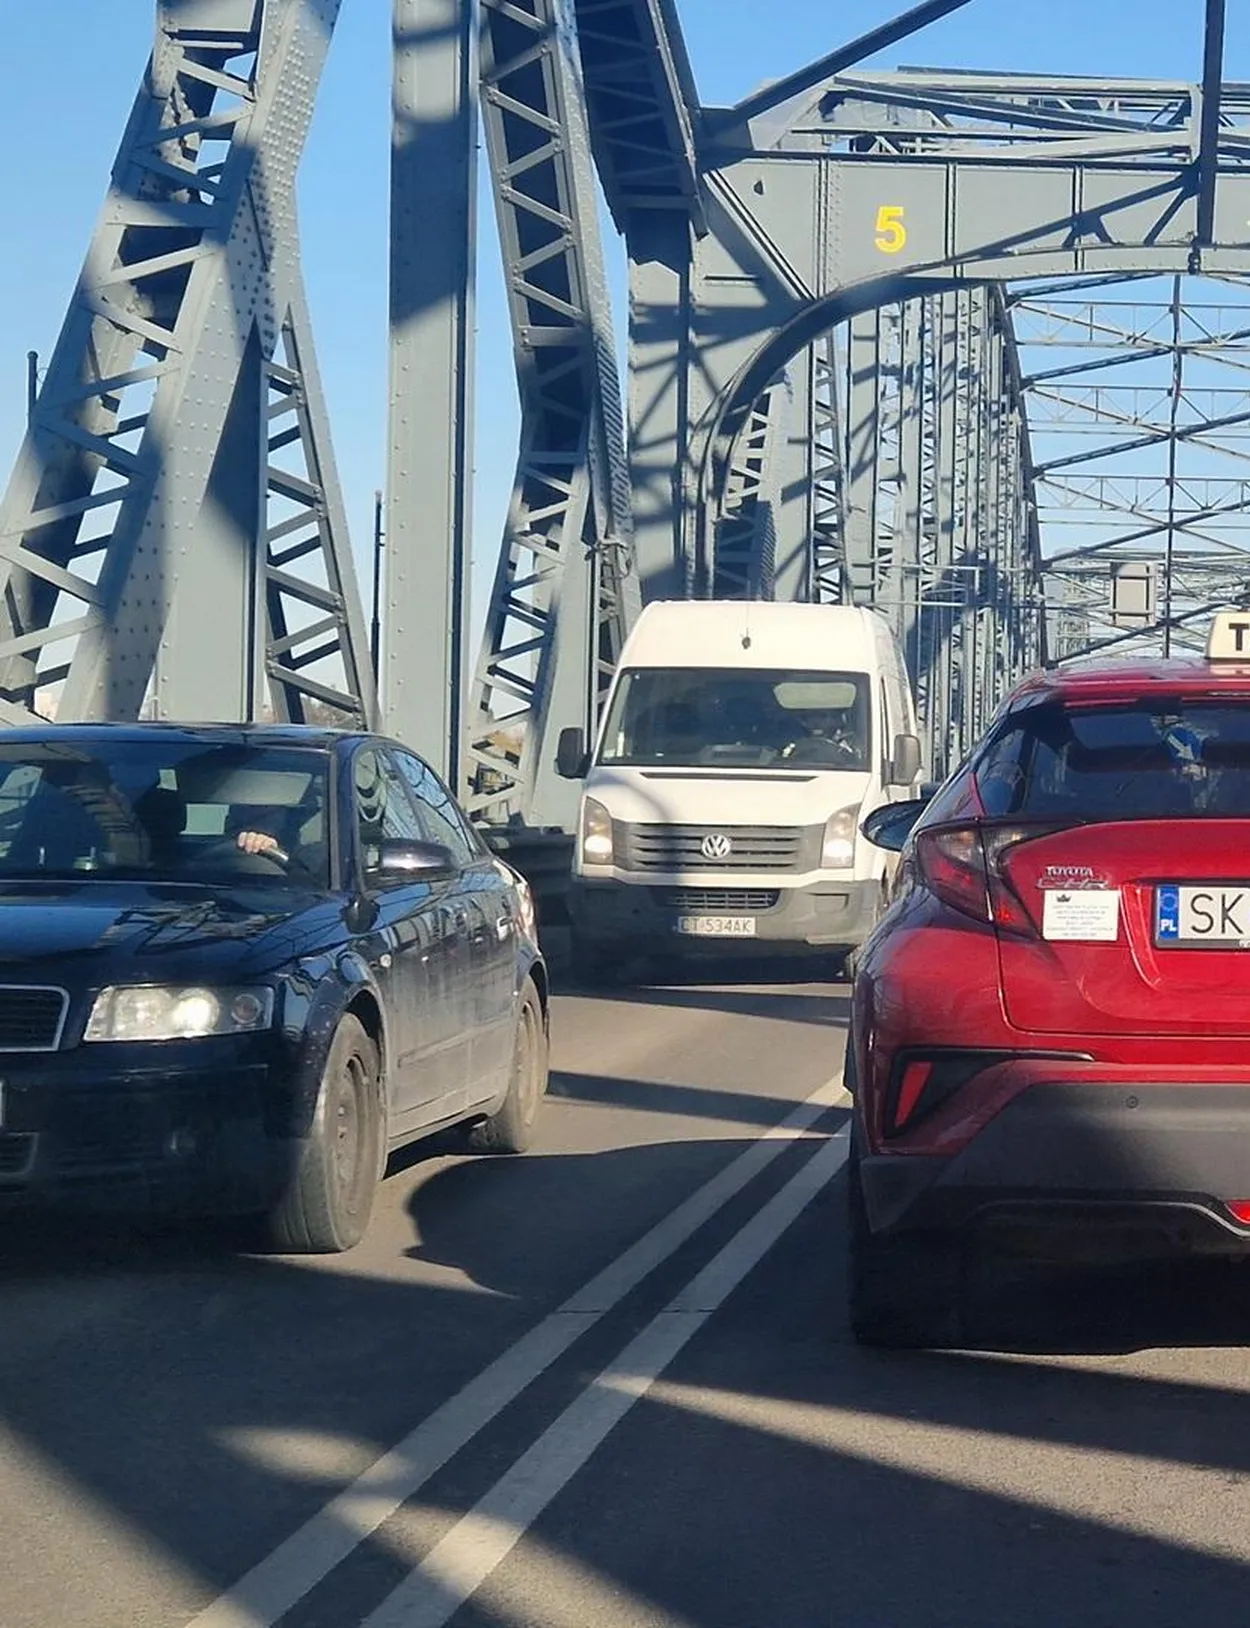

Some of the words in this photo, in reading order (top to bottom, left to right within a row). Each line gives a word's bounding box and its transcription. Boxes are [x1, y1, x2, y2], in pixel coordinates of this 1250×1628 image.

[875, 205, 906, 253] 5
[1046, 866, 1094, 876] TOYOTA
[1160, 919, 1177, 932] PL
[1190, 893, 1244, 934] SK
